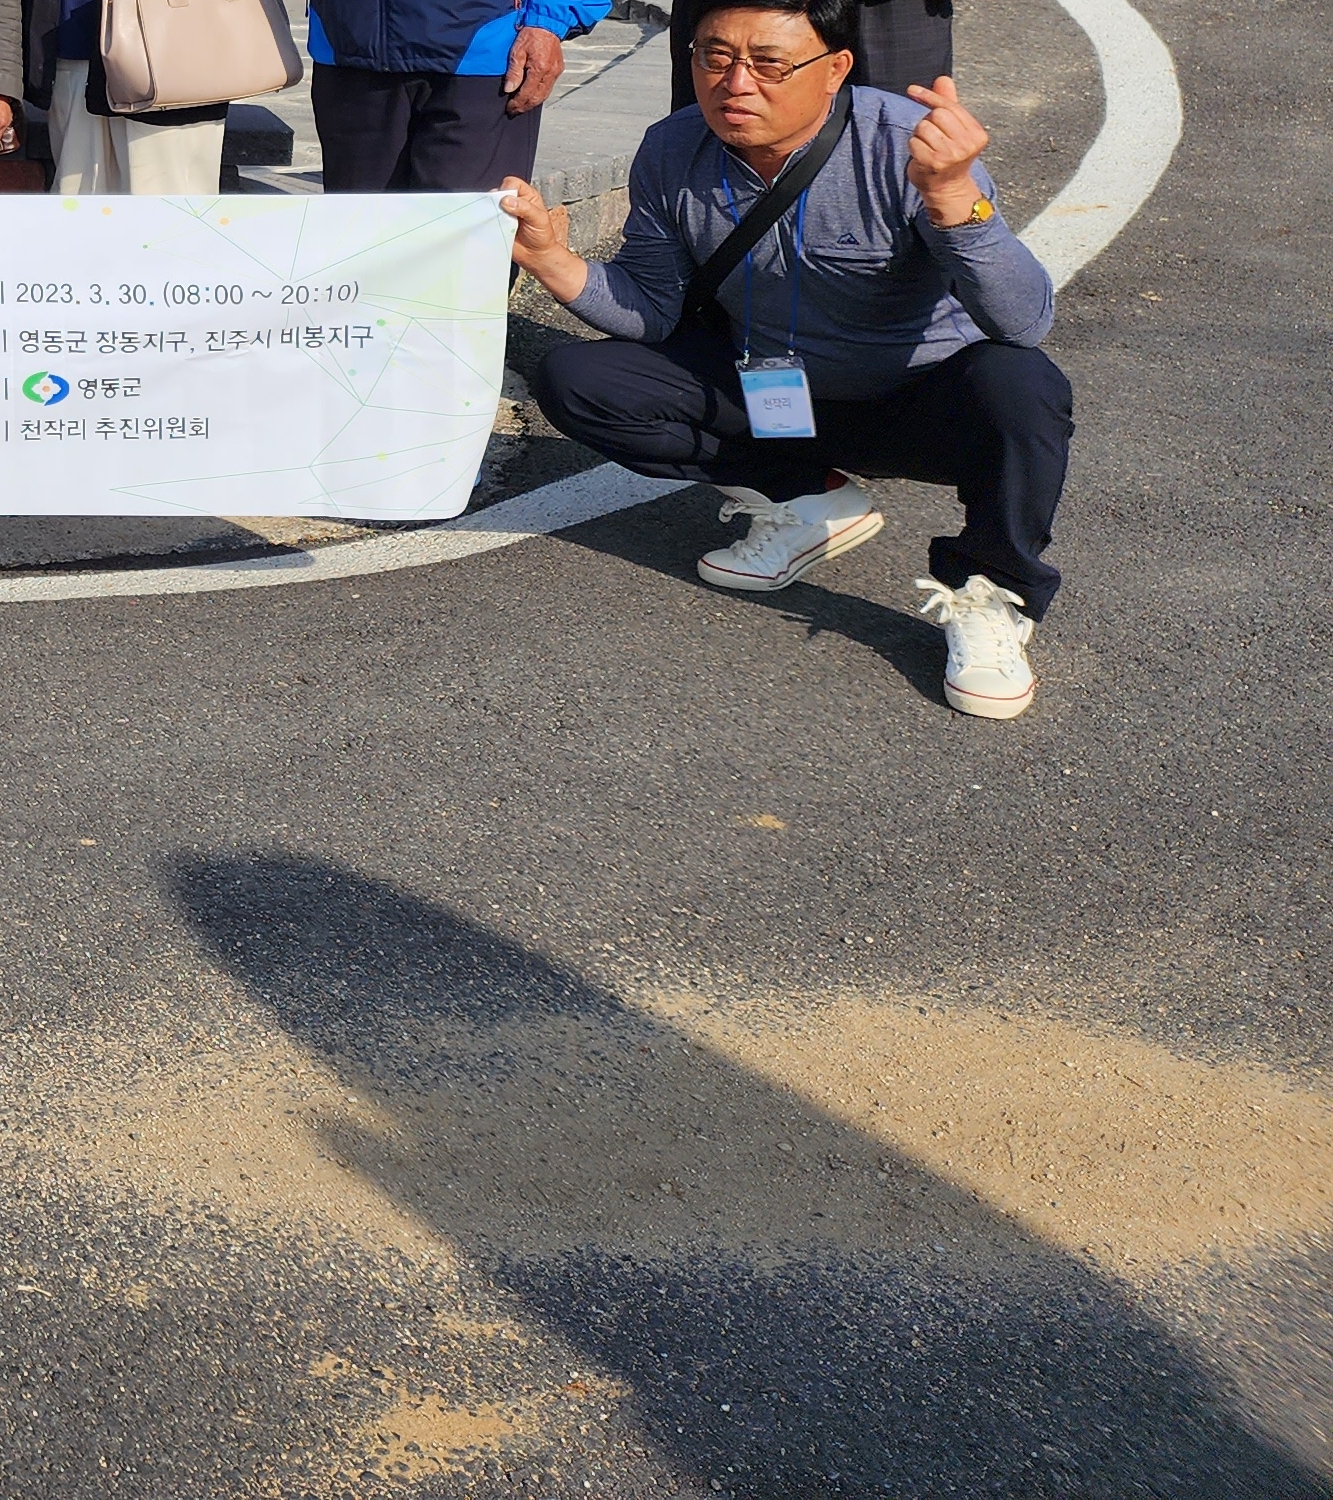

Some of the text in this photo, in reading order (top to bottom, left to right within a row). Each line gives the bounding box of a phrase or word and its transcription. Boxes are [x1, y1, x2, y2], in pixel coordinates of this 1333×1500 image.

[16, 282, 81, 305] 2023.
[89, 282, 110, 305] 3.
[118, 282, 155, 305] 30.
[163, 281, 244, 308] (08:00
[281, 280, 359, 305] 20:10)
[18, 329, 88, 354] 영동군
[95, 330, 195, 355] 장동지구,
[204, 328, 272, 352] 진주시
[280, 324, 375, 350] 비봉지구
[77, 377, 142, 400] 영동군
[20, 418, 87, 442] 천작리
[94, 417, 210, 441] 추진위원회
